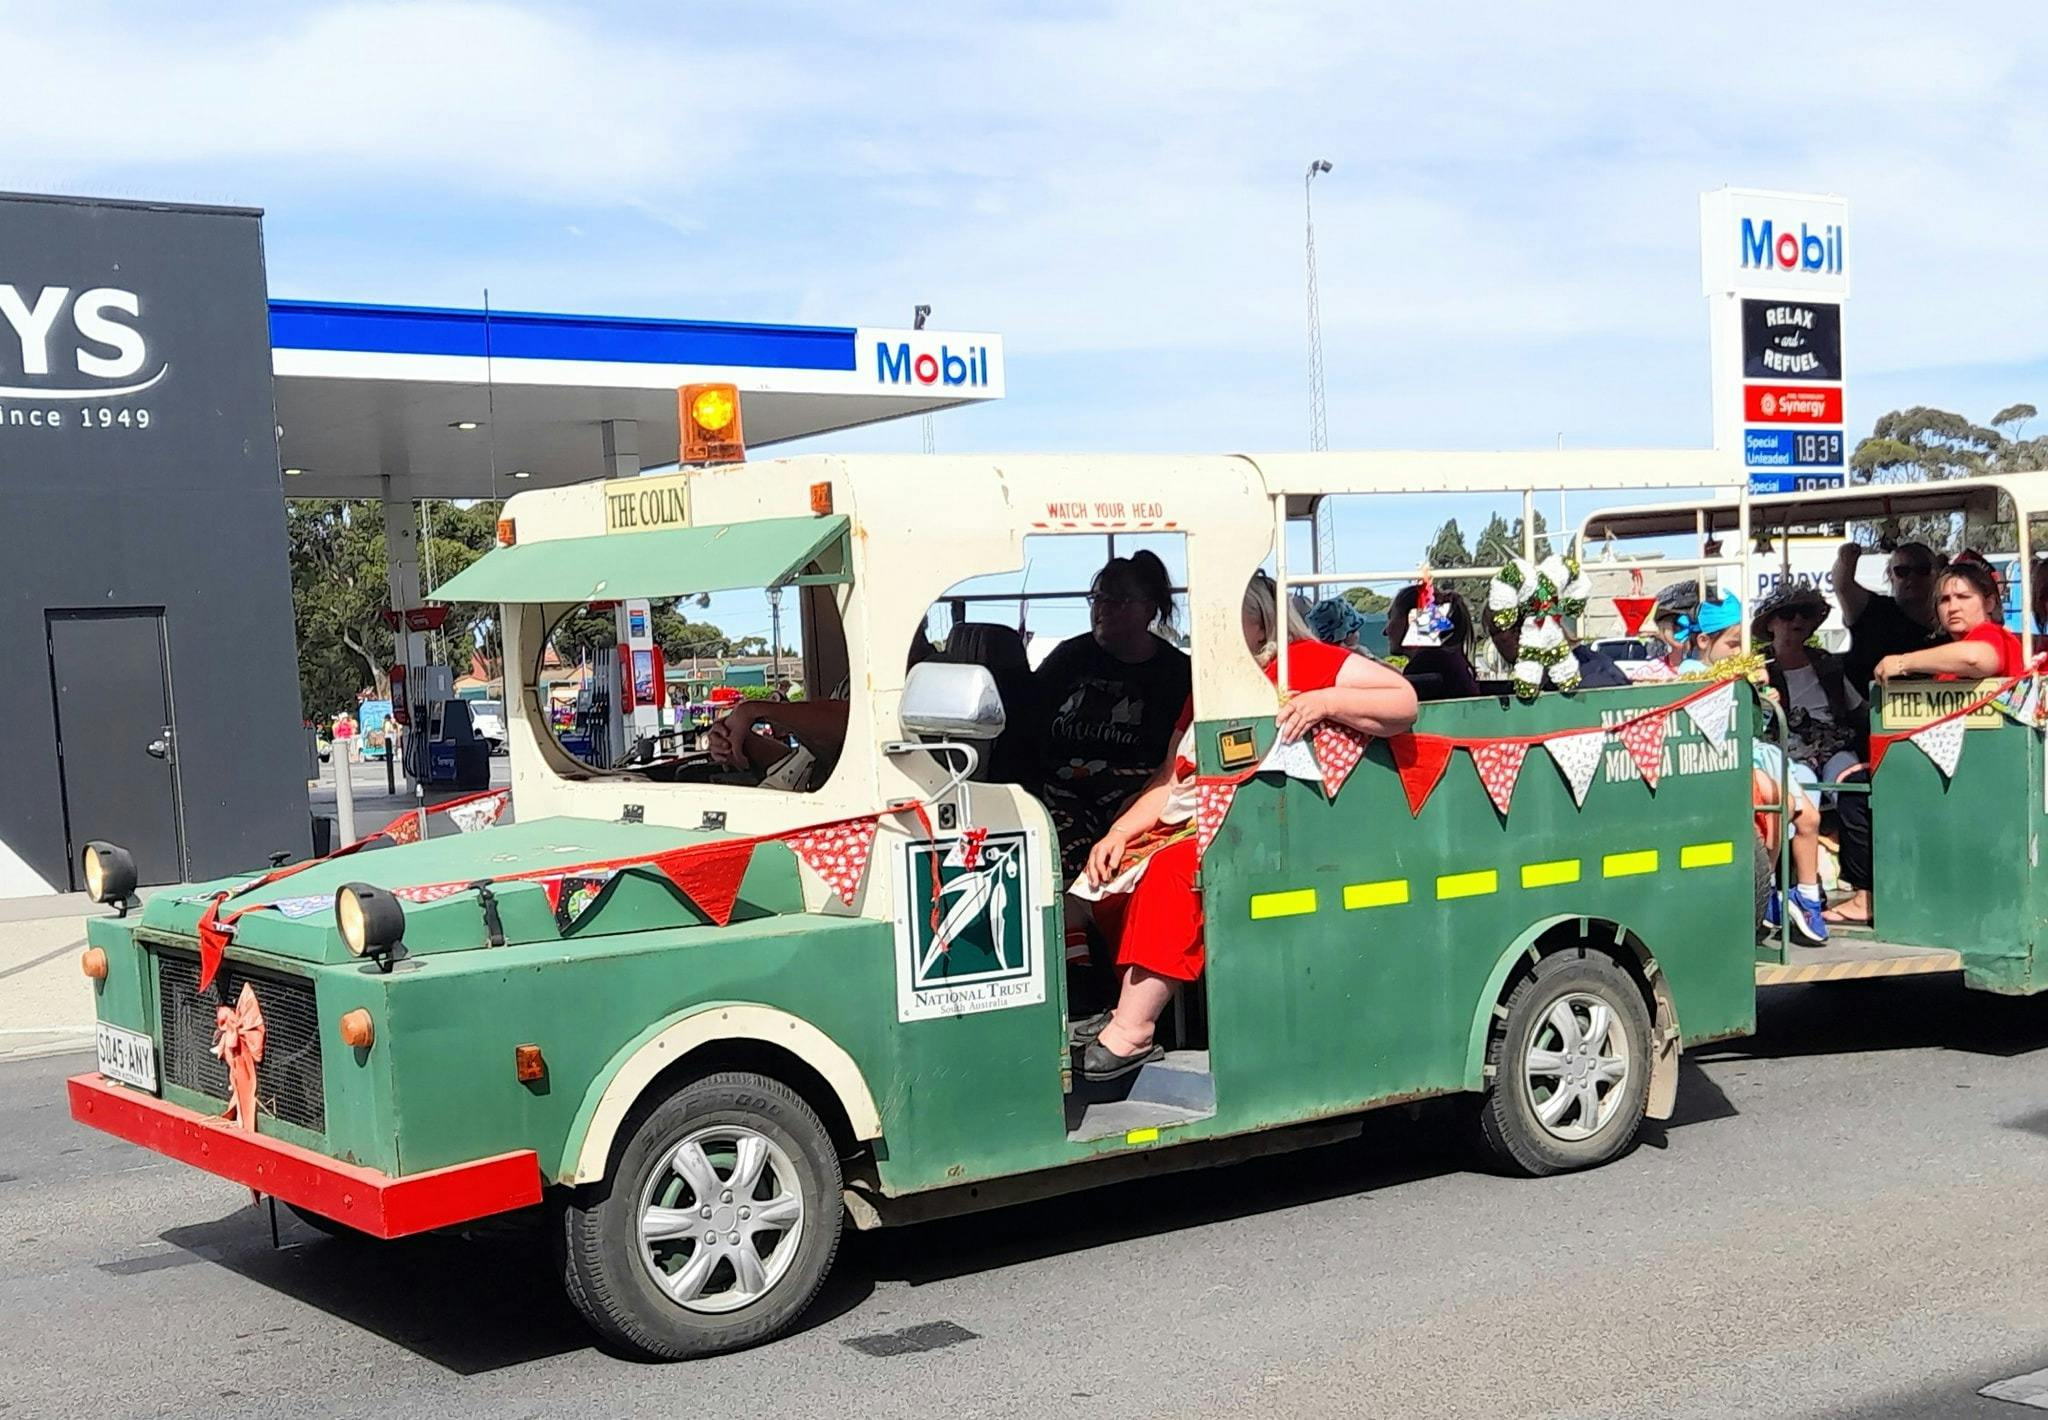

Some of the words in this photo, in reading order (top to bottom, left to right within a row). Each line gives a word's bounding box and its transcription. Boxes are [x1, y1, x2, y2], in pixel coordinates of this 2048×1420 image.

[1741, 217, 1843, 274] Mobil
[1766, 307, 1813, 329] RELAX
[1781, 330, 1799, 348] and
[877, 341, 988, 387] Mobil
[1763, 349, 1819, 373] REFUEL
[1779, 395, 1826, 418] Synergy
[81, 408, 151, 428] 1949
[1747, 434, 1779, 450] Special
[1747, 451, 1789, 465] Unleaded
[1749, 478, 1780, 495] Special
[608, 493, 637, 528] THE
[639, 487, 685, 525] COLIN
[1047, 503, 1087, 518] WATCH
[1094, 503, 1125, 518] YOUR
[1132, 502, 1163, 518] HEAD
[1888, 691, 1923, 717] THE
[1679, 738, 1739, 775] BRANCH
[969, 998, 1008, 1011] Australia
